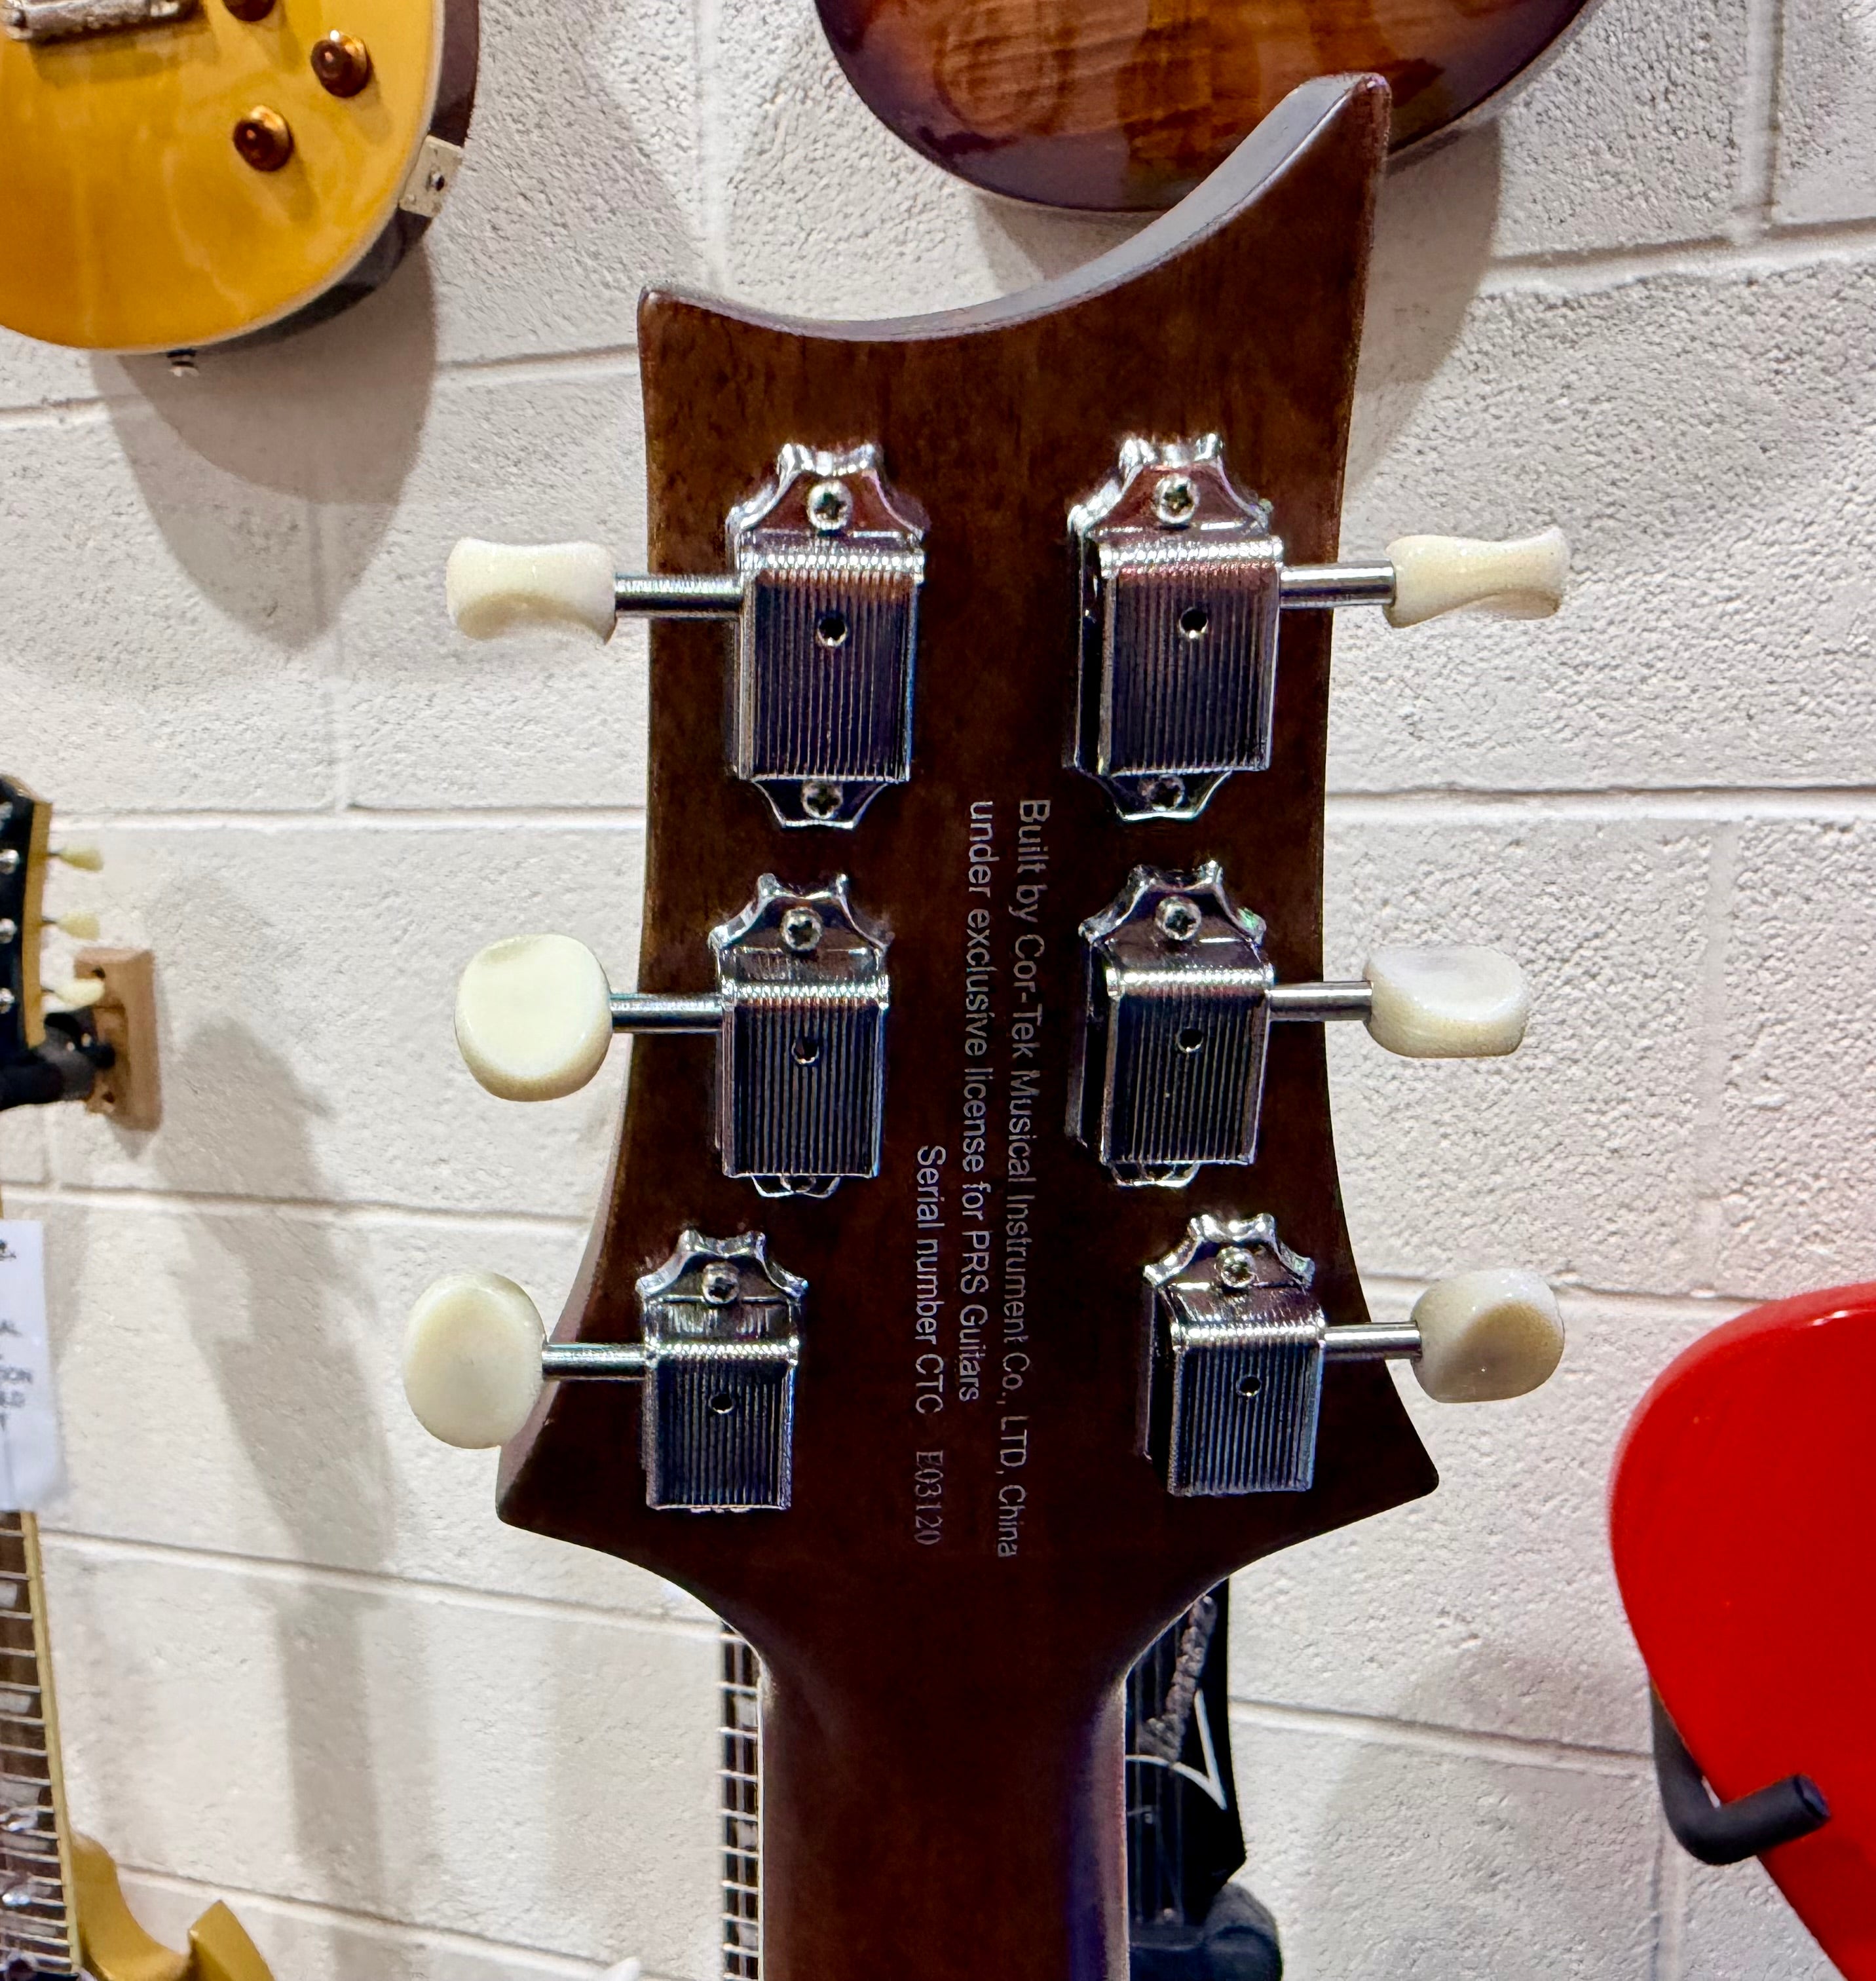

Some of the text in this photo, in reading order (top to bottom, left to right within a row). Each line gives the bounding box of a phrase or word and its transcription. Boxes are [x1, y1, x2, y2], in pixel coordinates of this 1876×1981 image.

[958, 801, 1000, 1402] under exclusive license for PRS Guitars
[916, 1145, 947, 1229] Serial
[995, 800, 1051, 1558] Built by Cor-Tek Musical Instrument Co., LTD, China
[914, 1238, 945, 1345] number
[915, 1353, 945, 1414] CTC
